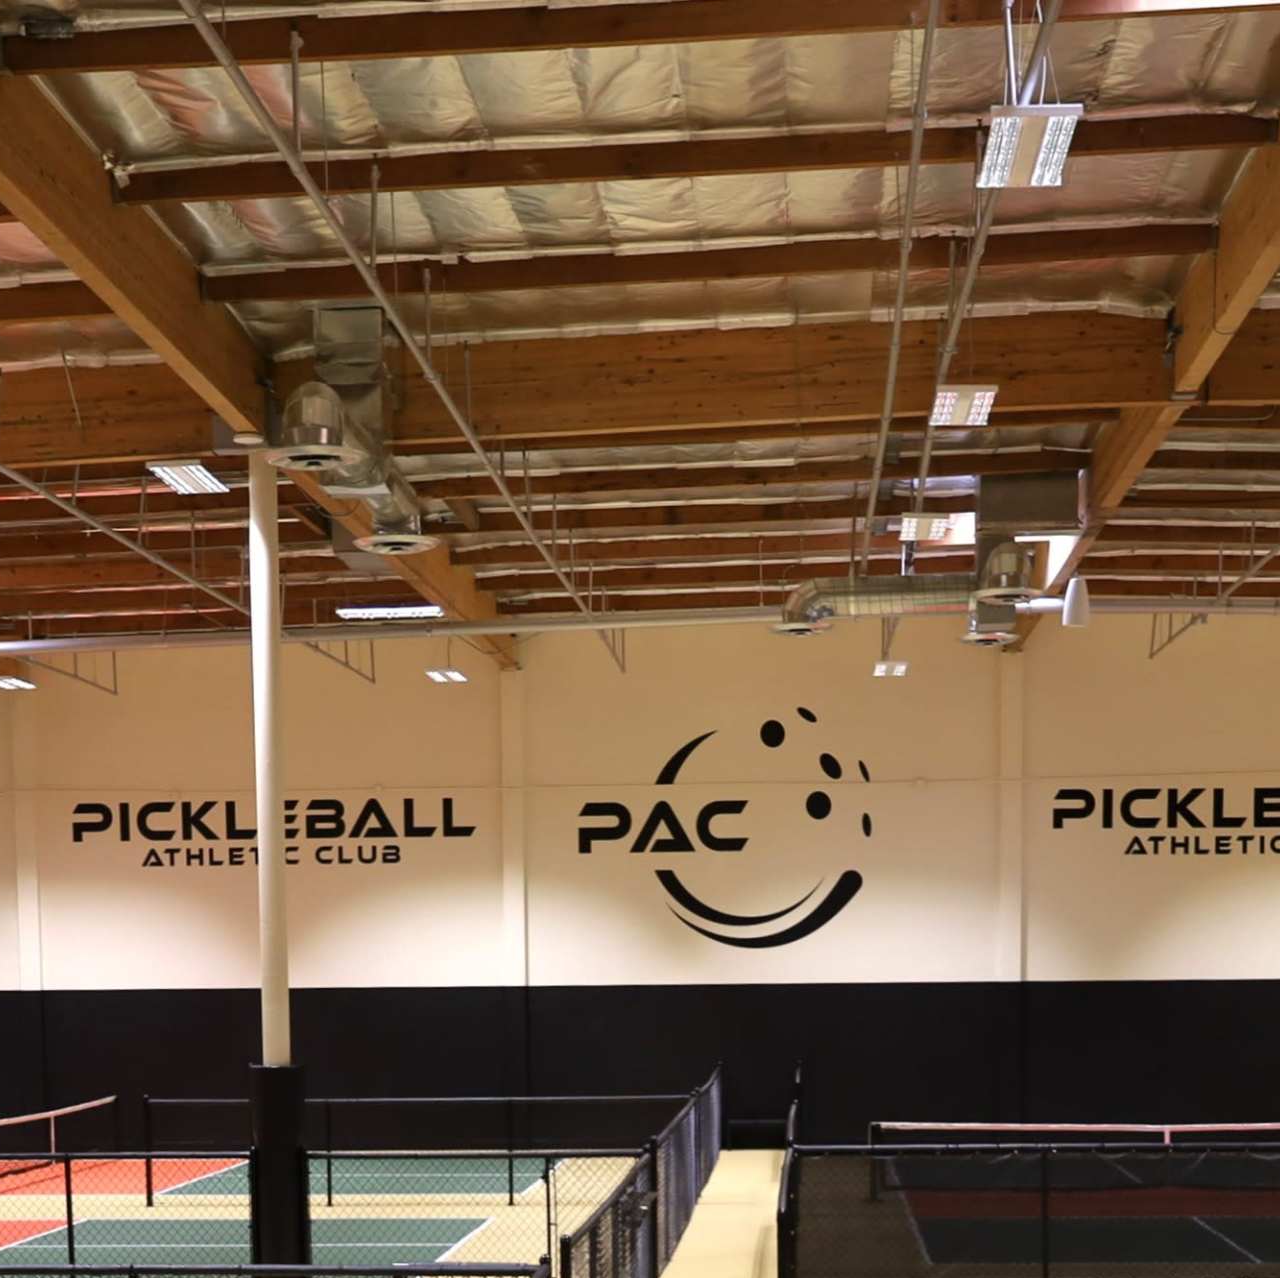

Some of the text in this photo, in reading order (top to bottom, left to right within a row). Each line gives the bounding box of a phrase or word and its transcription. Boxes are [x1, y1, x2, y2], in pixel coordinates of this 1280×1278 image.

[578, 800, 749, 854] PAC
[142, 844, 402, 868] ATHLETC CLUB
